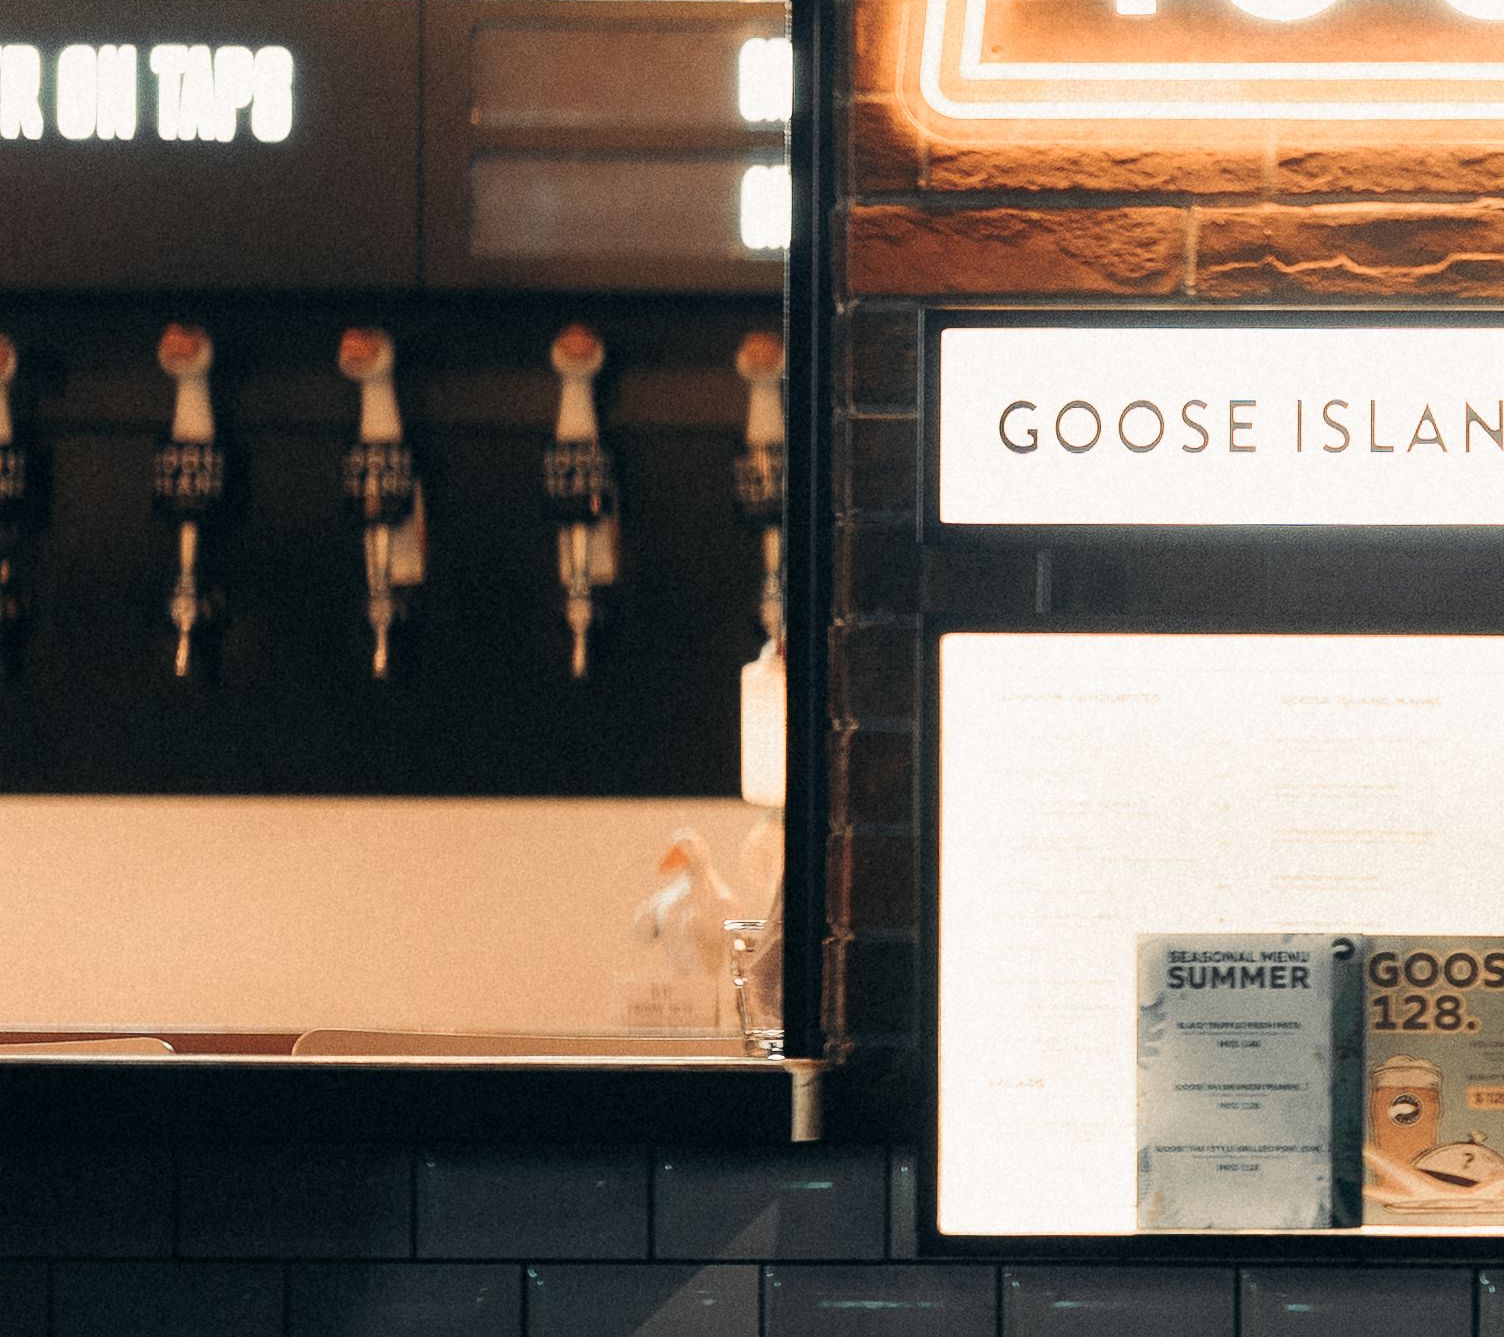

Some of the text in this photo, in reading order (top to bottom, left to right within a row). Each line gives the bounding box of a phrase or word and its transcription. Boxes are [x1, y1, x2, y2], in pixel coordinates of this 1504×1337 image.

[56, 43, 138, 141] ON
[149, 43, 294, 143] TAPS
[998, 399, 1257, 454] GOOSE
[1166, 965, 1312, 990] SUMMER
[1373, 994, 1479, 1031] 128.
